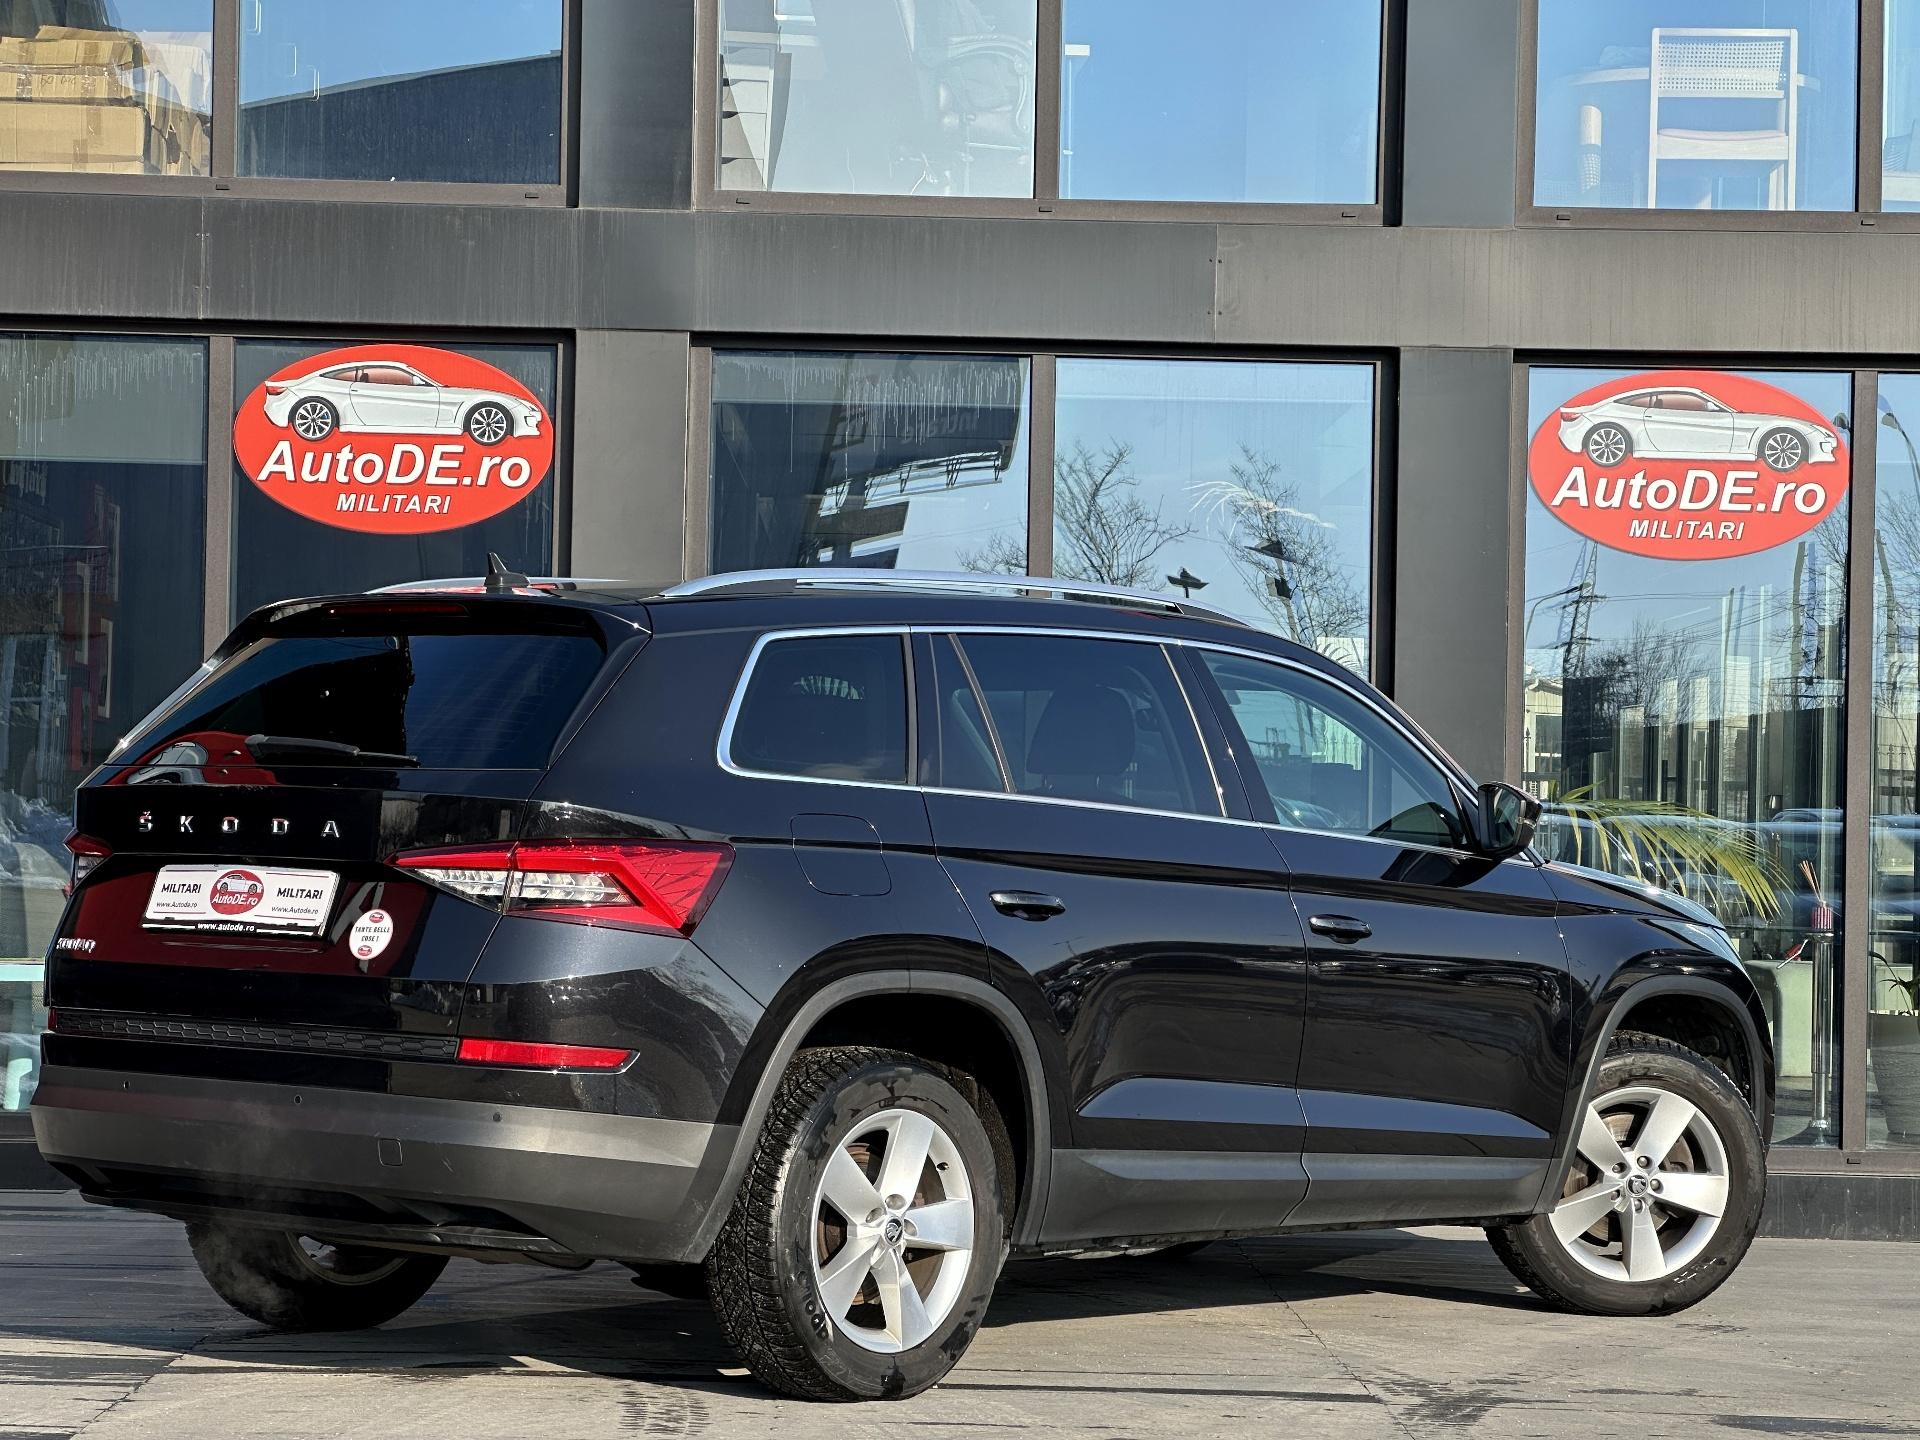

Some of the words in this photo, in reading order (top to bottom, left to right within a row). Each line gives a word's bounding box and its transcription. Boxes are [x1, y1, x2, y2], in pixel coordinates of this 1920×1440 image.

[257, 440, 532, 488] AutoDE.ro
[1551, 466, 1827, 514] AutoDE.ro
[336, 494, 452, 514] MILITARI
[1628, 519, 1745, 540] MILITARI
[161, 883, 202, 893] MILITARI
[276, 887, 324, 900] MILITARI
[211, 893, 259, 905] AutoDE.ro
[197, 922, 255, 932] www.autode.ro
